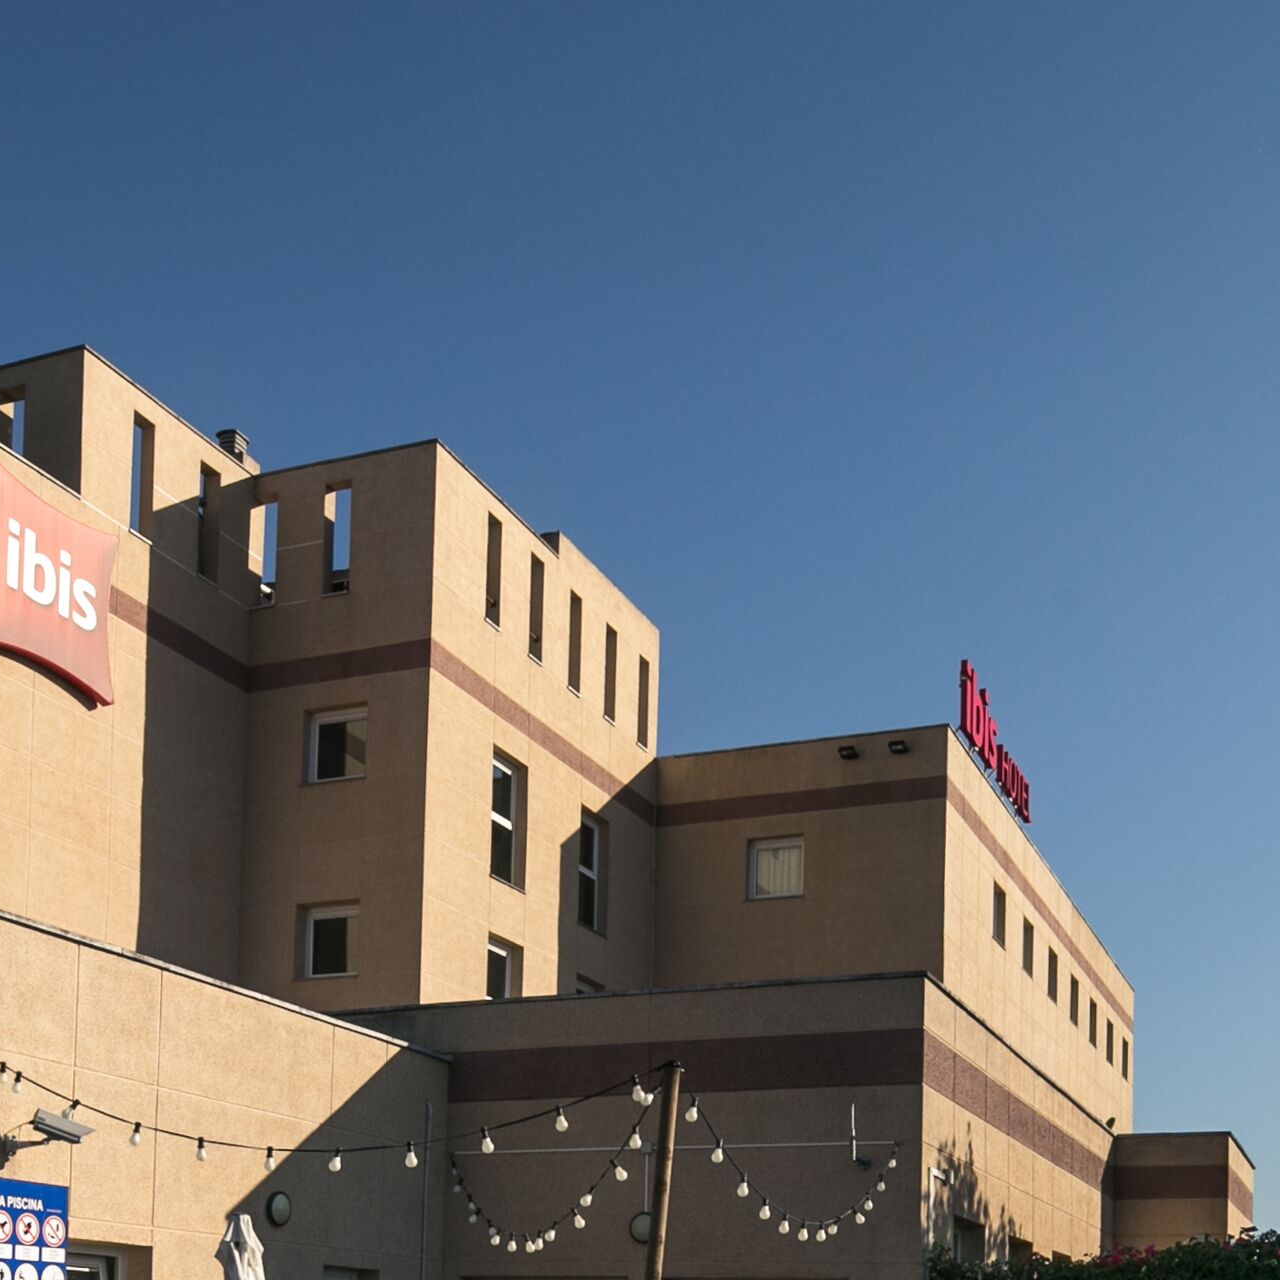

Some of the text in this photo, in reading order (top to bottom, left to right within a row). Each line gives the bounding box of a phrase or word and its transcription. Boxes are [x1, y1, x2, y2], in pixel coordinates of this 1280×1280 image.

[6, 518, 97, 632] ibis
[959, 659, 1032, 823] ibis HOTEL
[6, 1195, 44, 1212] PISCINA
